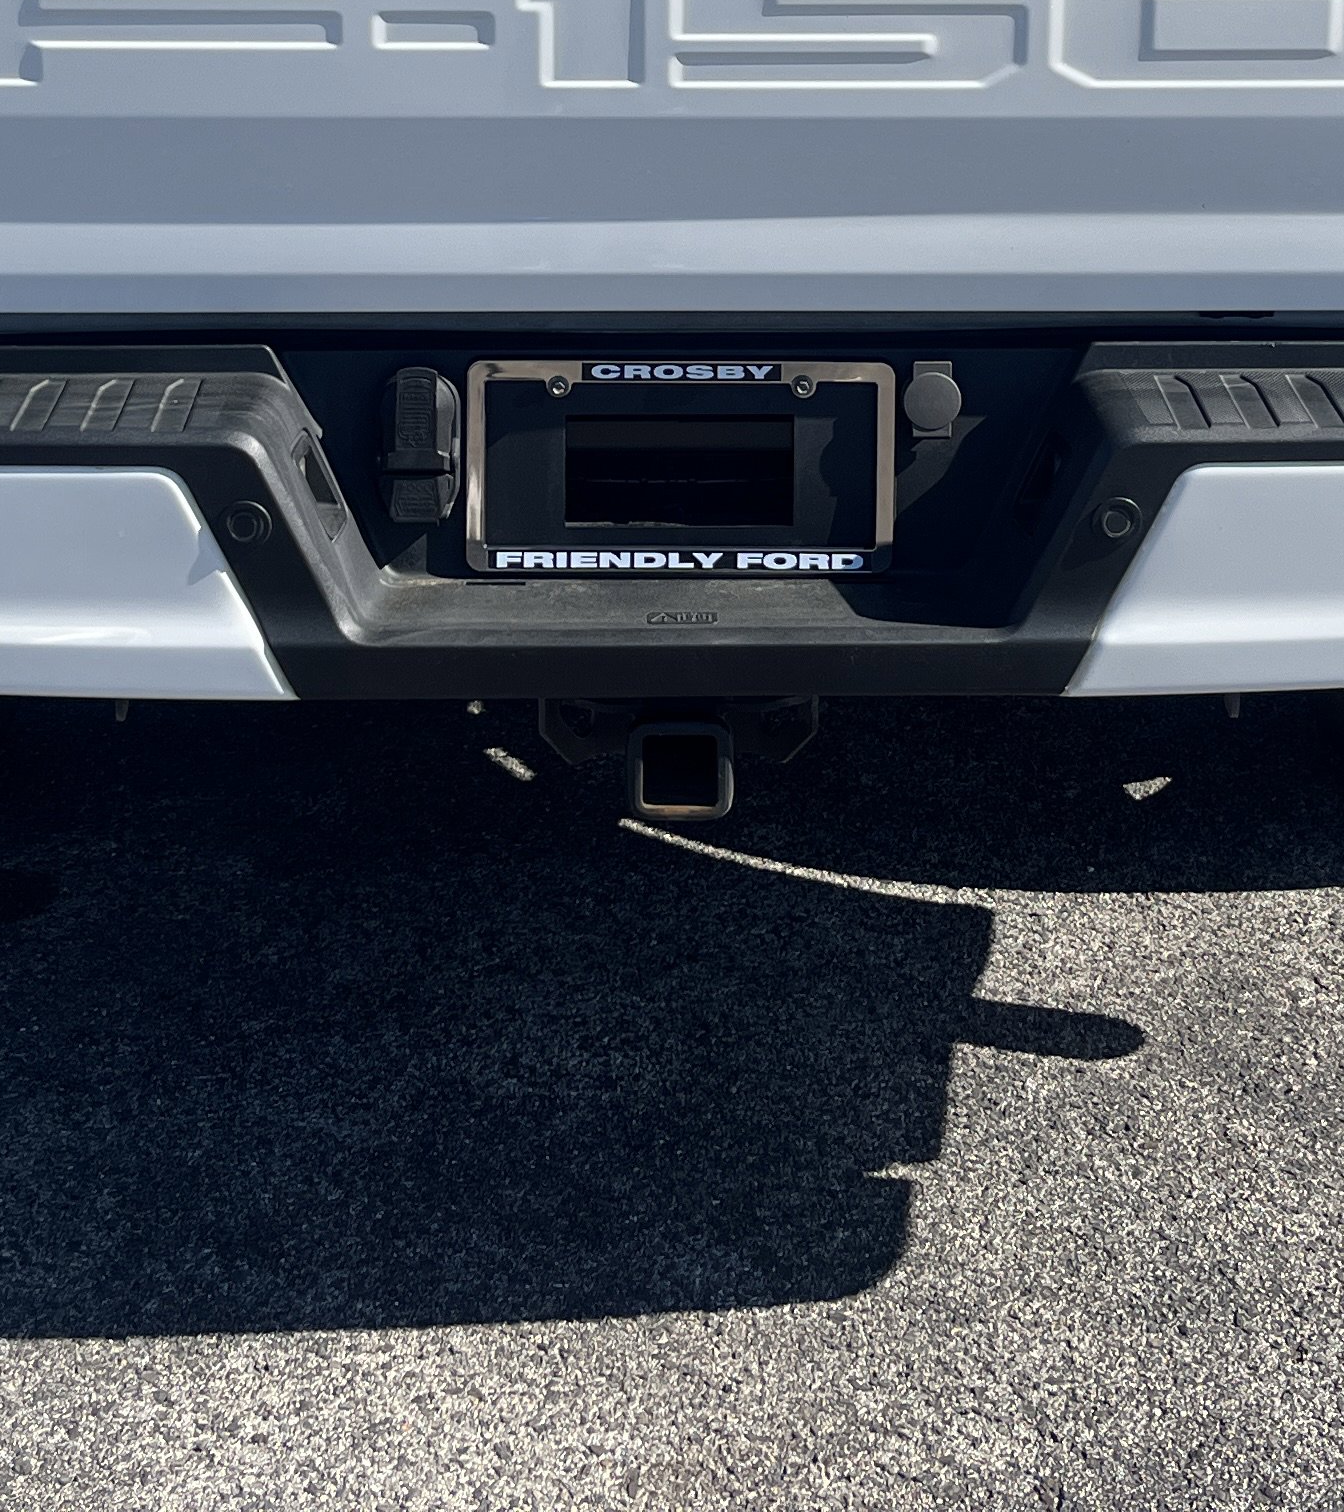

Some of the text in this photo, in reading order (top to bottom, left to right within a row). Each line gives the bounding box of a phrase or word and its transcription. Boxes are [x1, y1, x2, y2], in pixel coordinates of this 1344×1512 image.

[591, 363, 774, 380] CROSBY
[496, 551, 864, 571] FRIENDLY FORD
